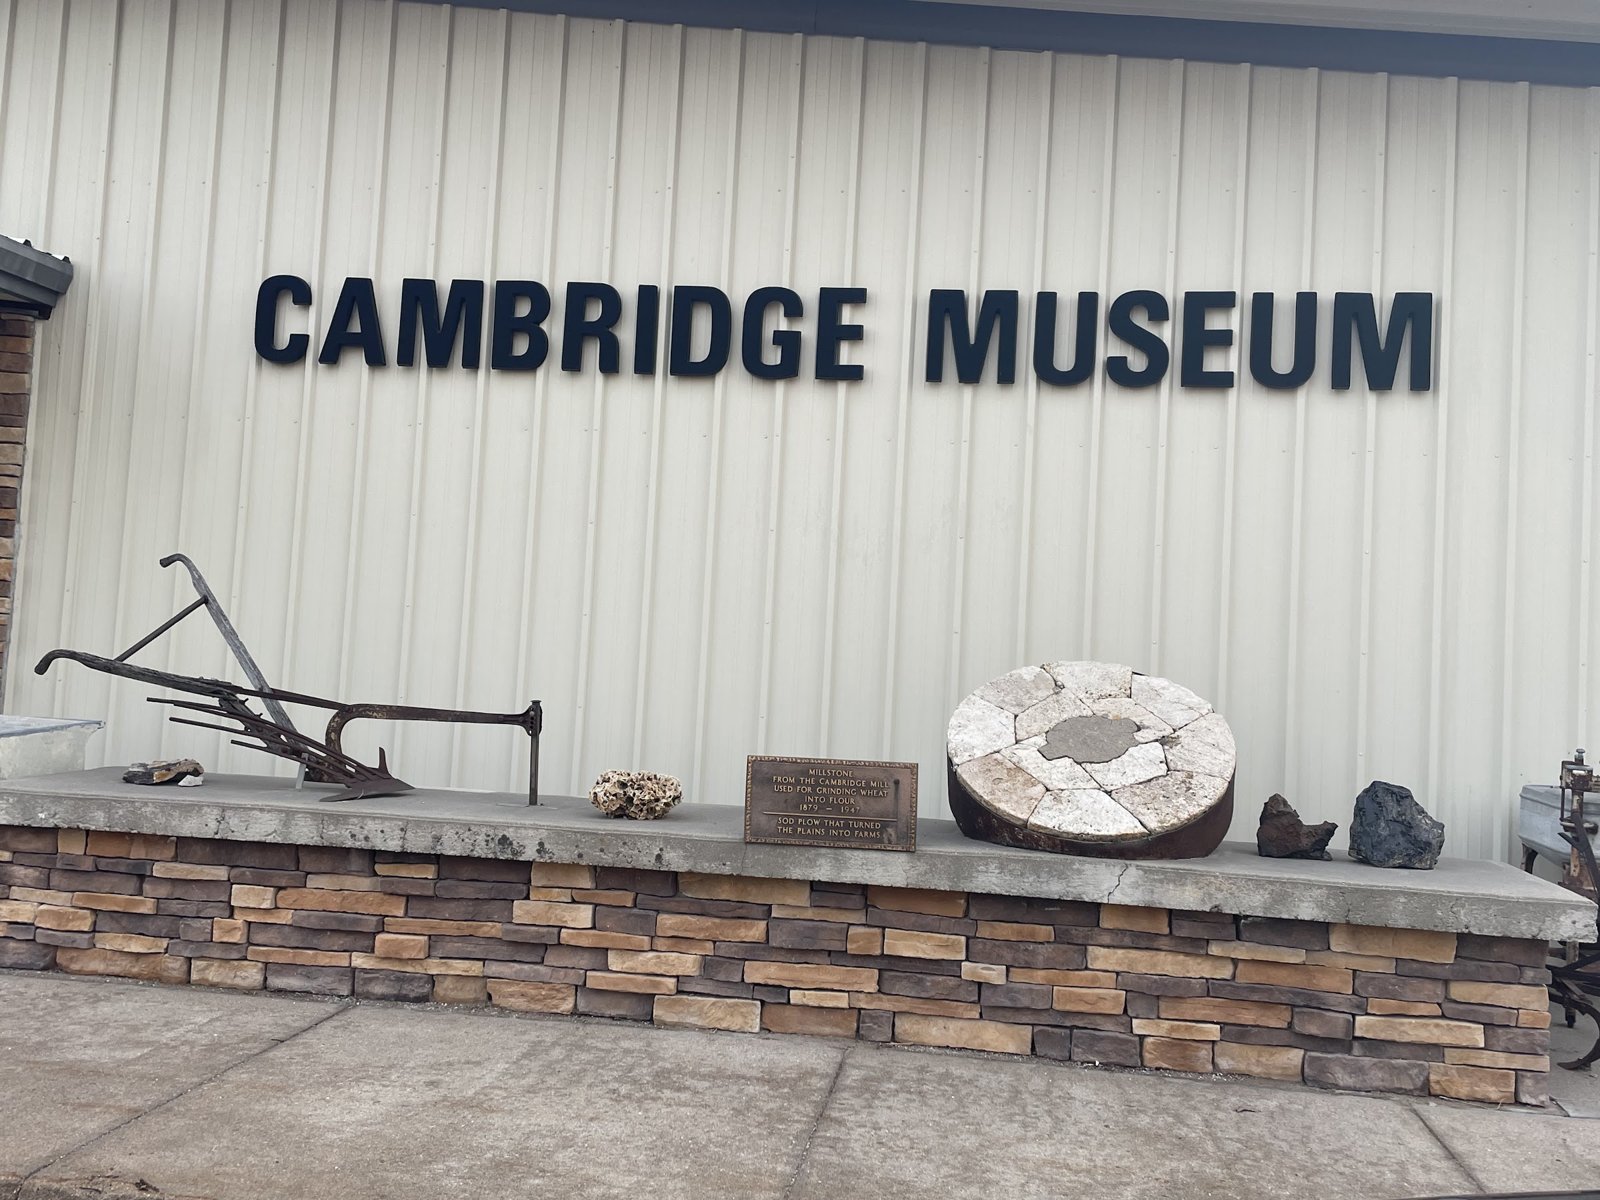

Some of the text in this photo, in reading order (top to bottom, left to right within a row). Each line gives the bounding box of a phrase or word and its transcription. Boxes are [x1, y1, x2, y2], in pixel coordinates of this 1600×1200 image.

[255, 275, 1435, 391] CAMBRIDGE MUSEUM
[809, 769, 853, 778] MILLSTONE
[800, 777, 816, 785] THE
[819, 778, 866, 787] CAMBRIDGE
[870, 780, 889, 788] MILL
[774, 785, 793, 793] USED
[816, 787, 857, 796] GRINDING
[860, 789, 888, 797] WHEAT
[829, 797, 856, 805] FLOUR
[841, 805, 861, 813] 1947
[777, 817, 881, 829] SOD PLOW THAT TURNED
[777, 826, 881, 839] THE PLAINS INTO FARMS
